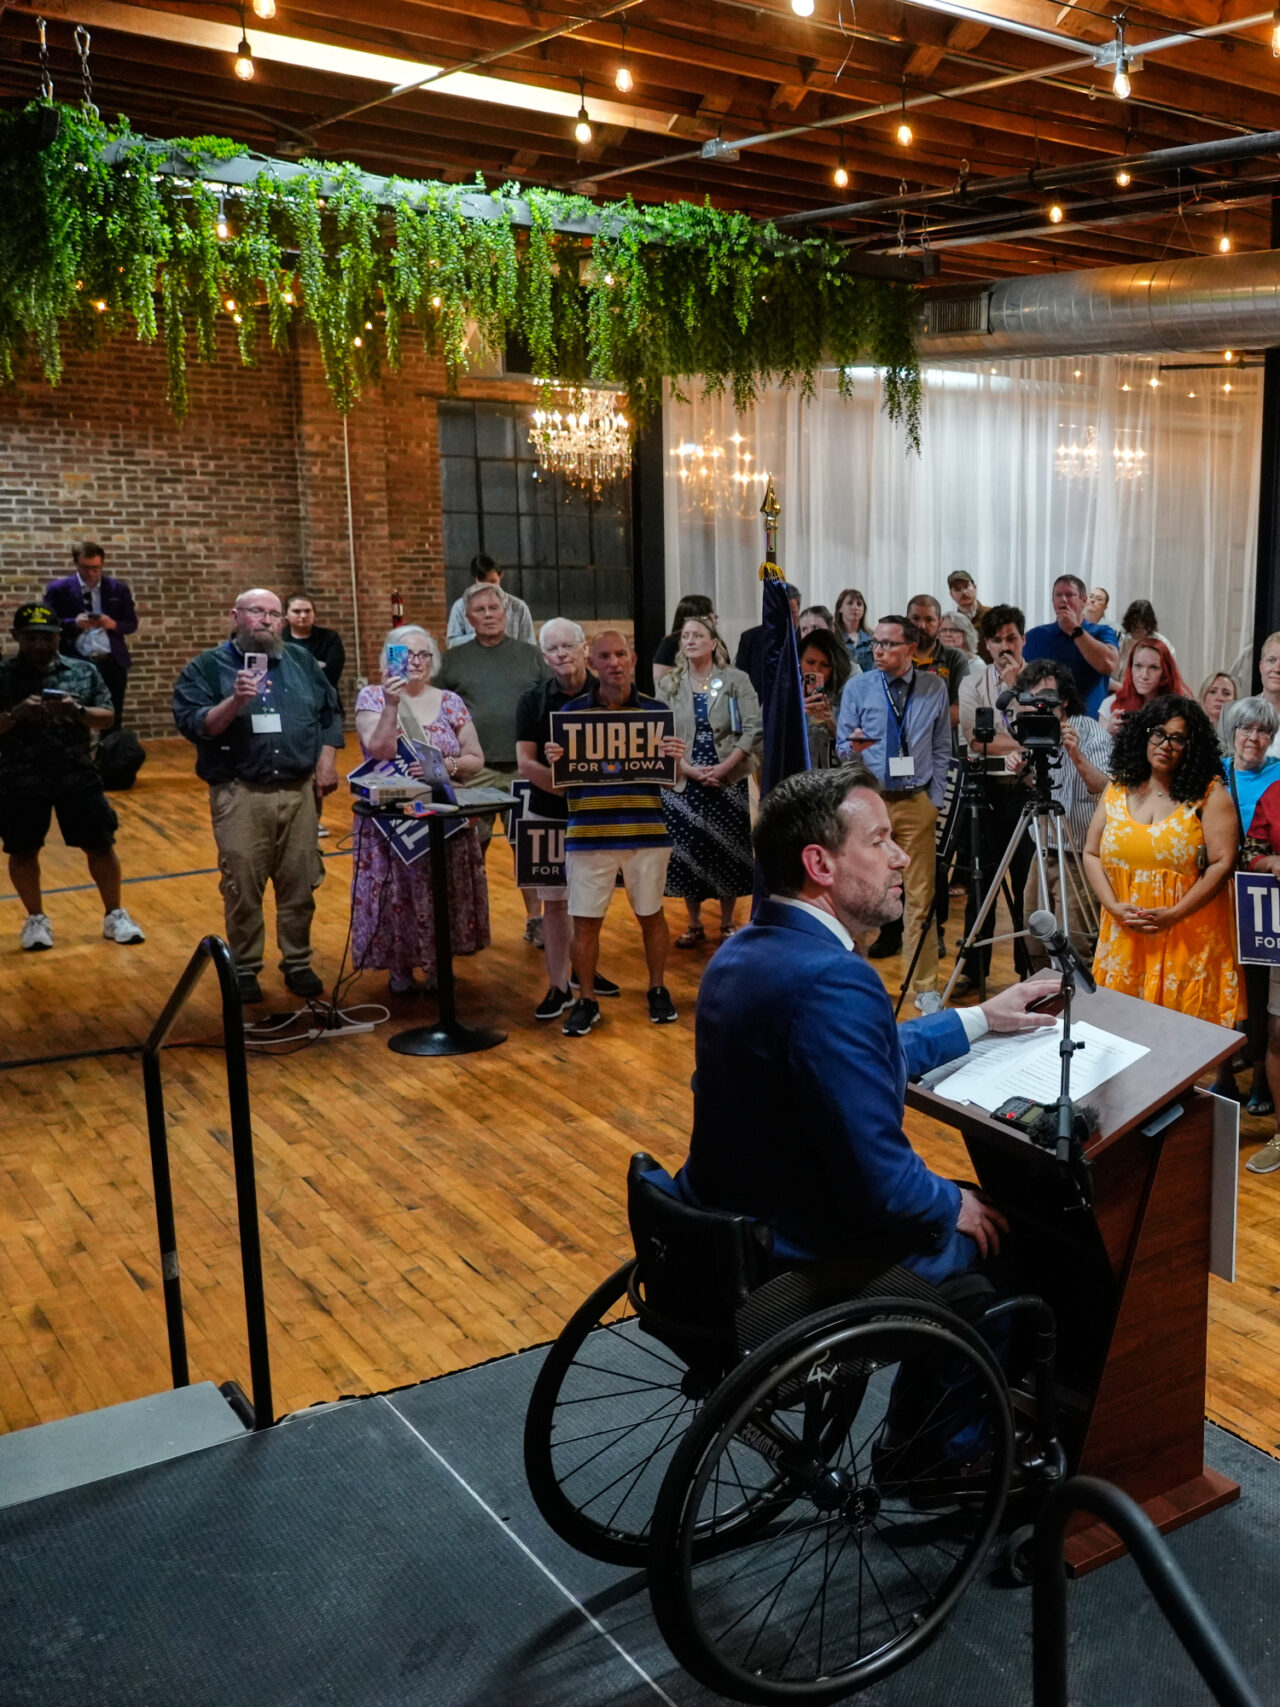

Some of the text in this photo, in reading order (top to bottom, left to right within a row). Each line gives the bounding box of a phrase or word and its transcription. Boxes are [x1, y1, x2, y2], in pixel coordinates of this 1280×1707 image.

[562, 721, 666, 760] TUREK
[568, 760, 665, 772] FOR IOWA
[532, 866, 560, 875] FOR
